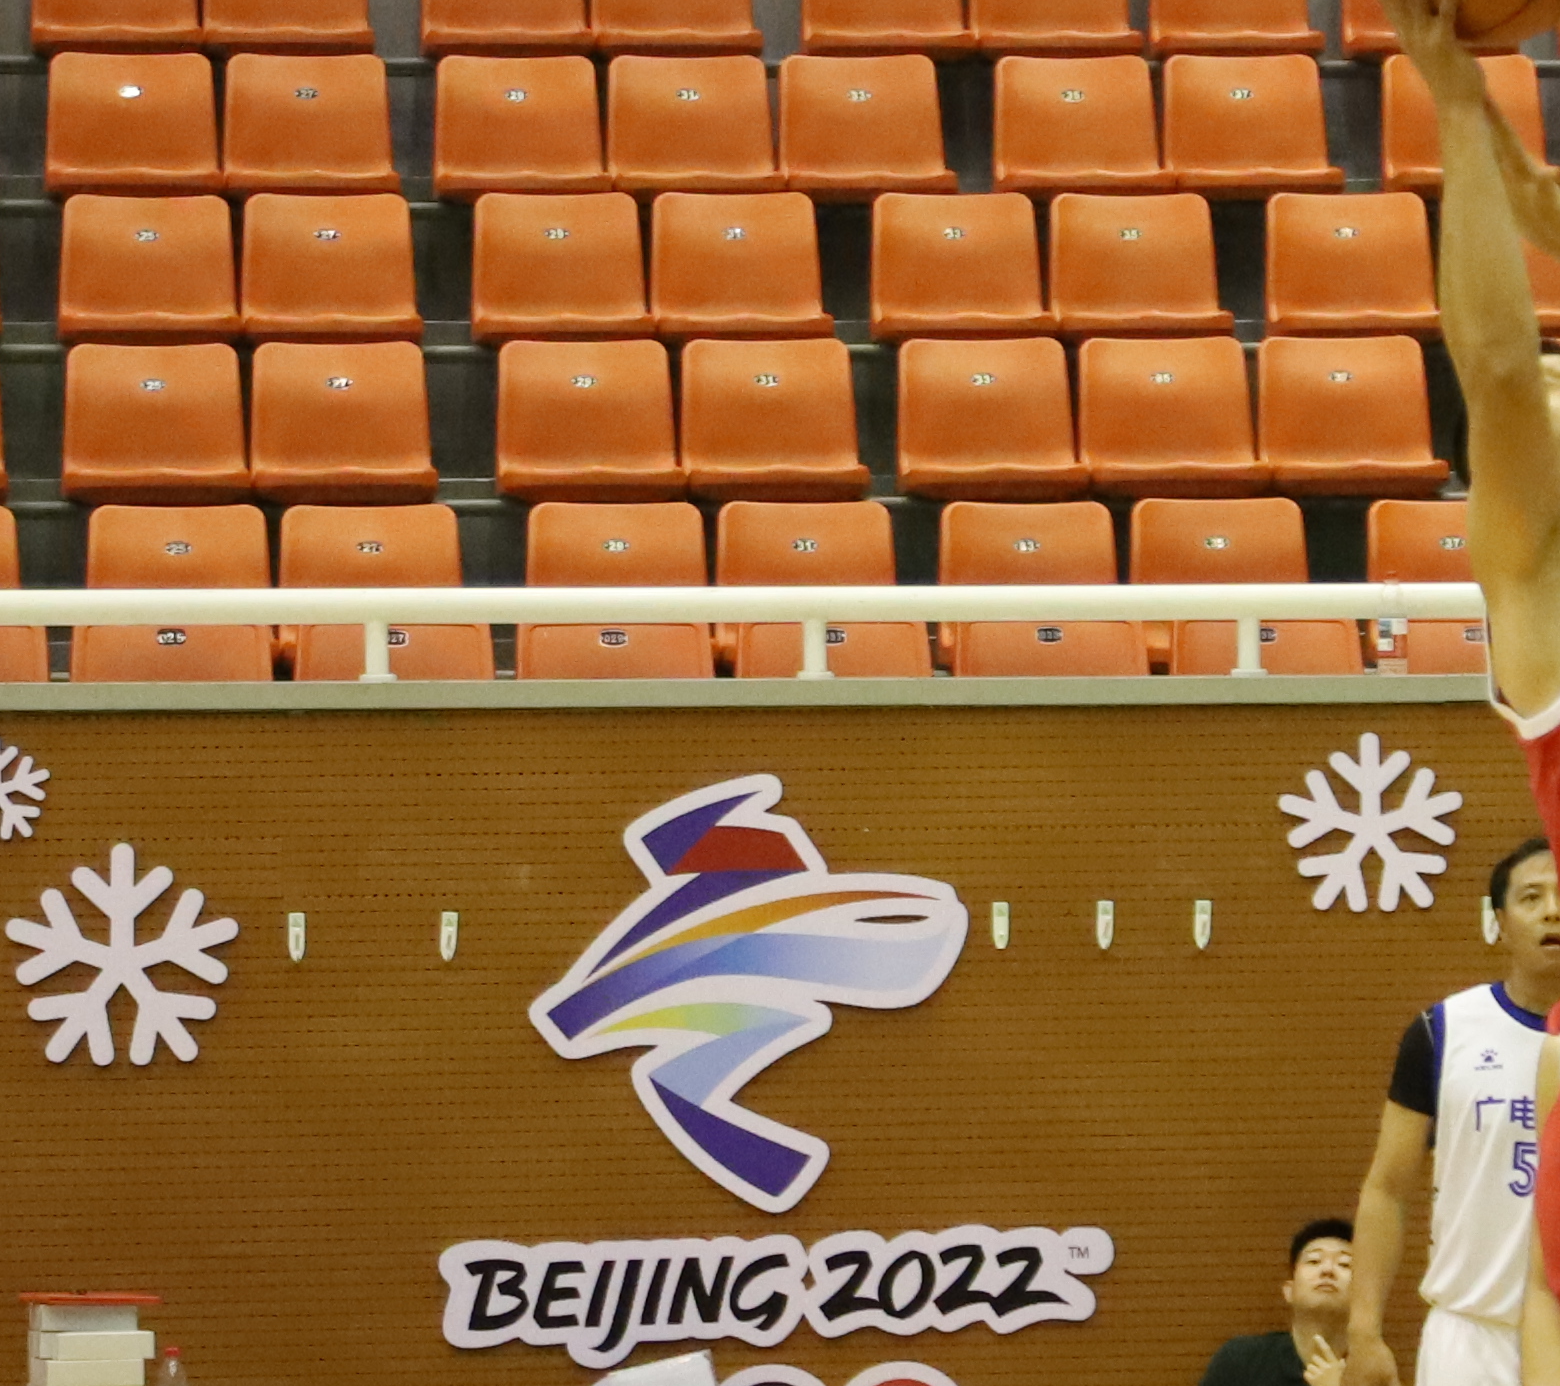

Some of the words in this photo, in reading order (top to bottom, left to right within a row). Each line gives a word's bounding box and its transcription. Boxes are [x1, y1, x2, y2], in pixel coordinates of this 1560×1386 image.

[1508, 1141, 1537, 1198] 5
[465, 1252, 789, 1354] BEIJING
[820, 1242, 1074, 1320] 2022
[1068, 1246, 1091, 1260] TM
